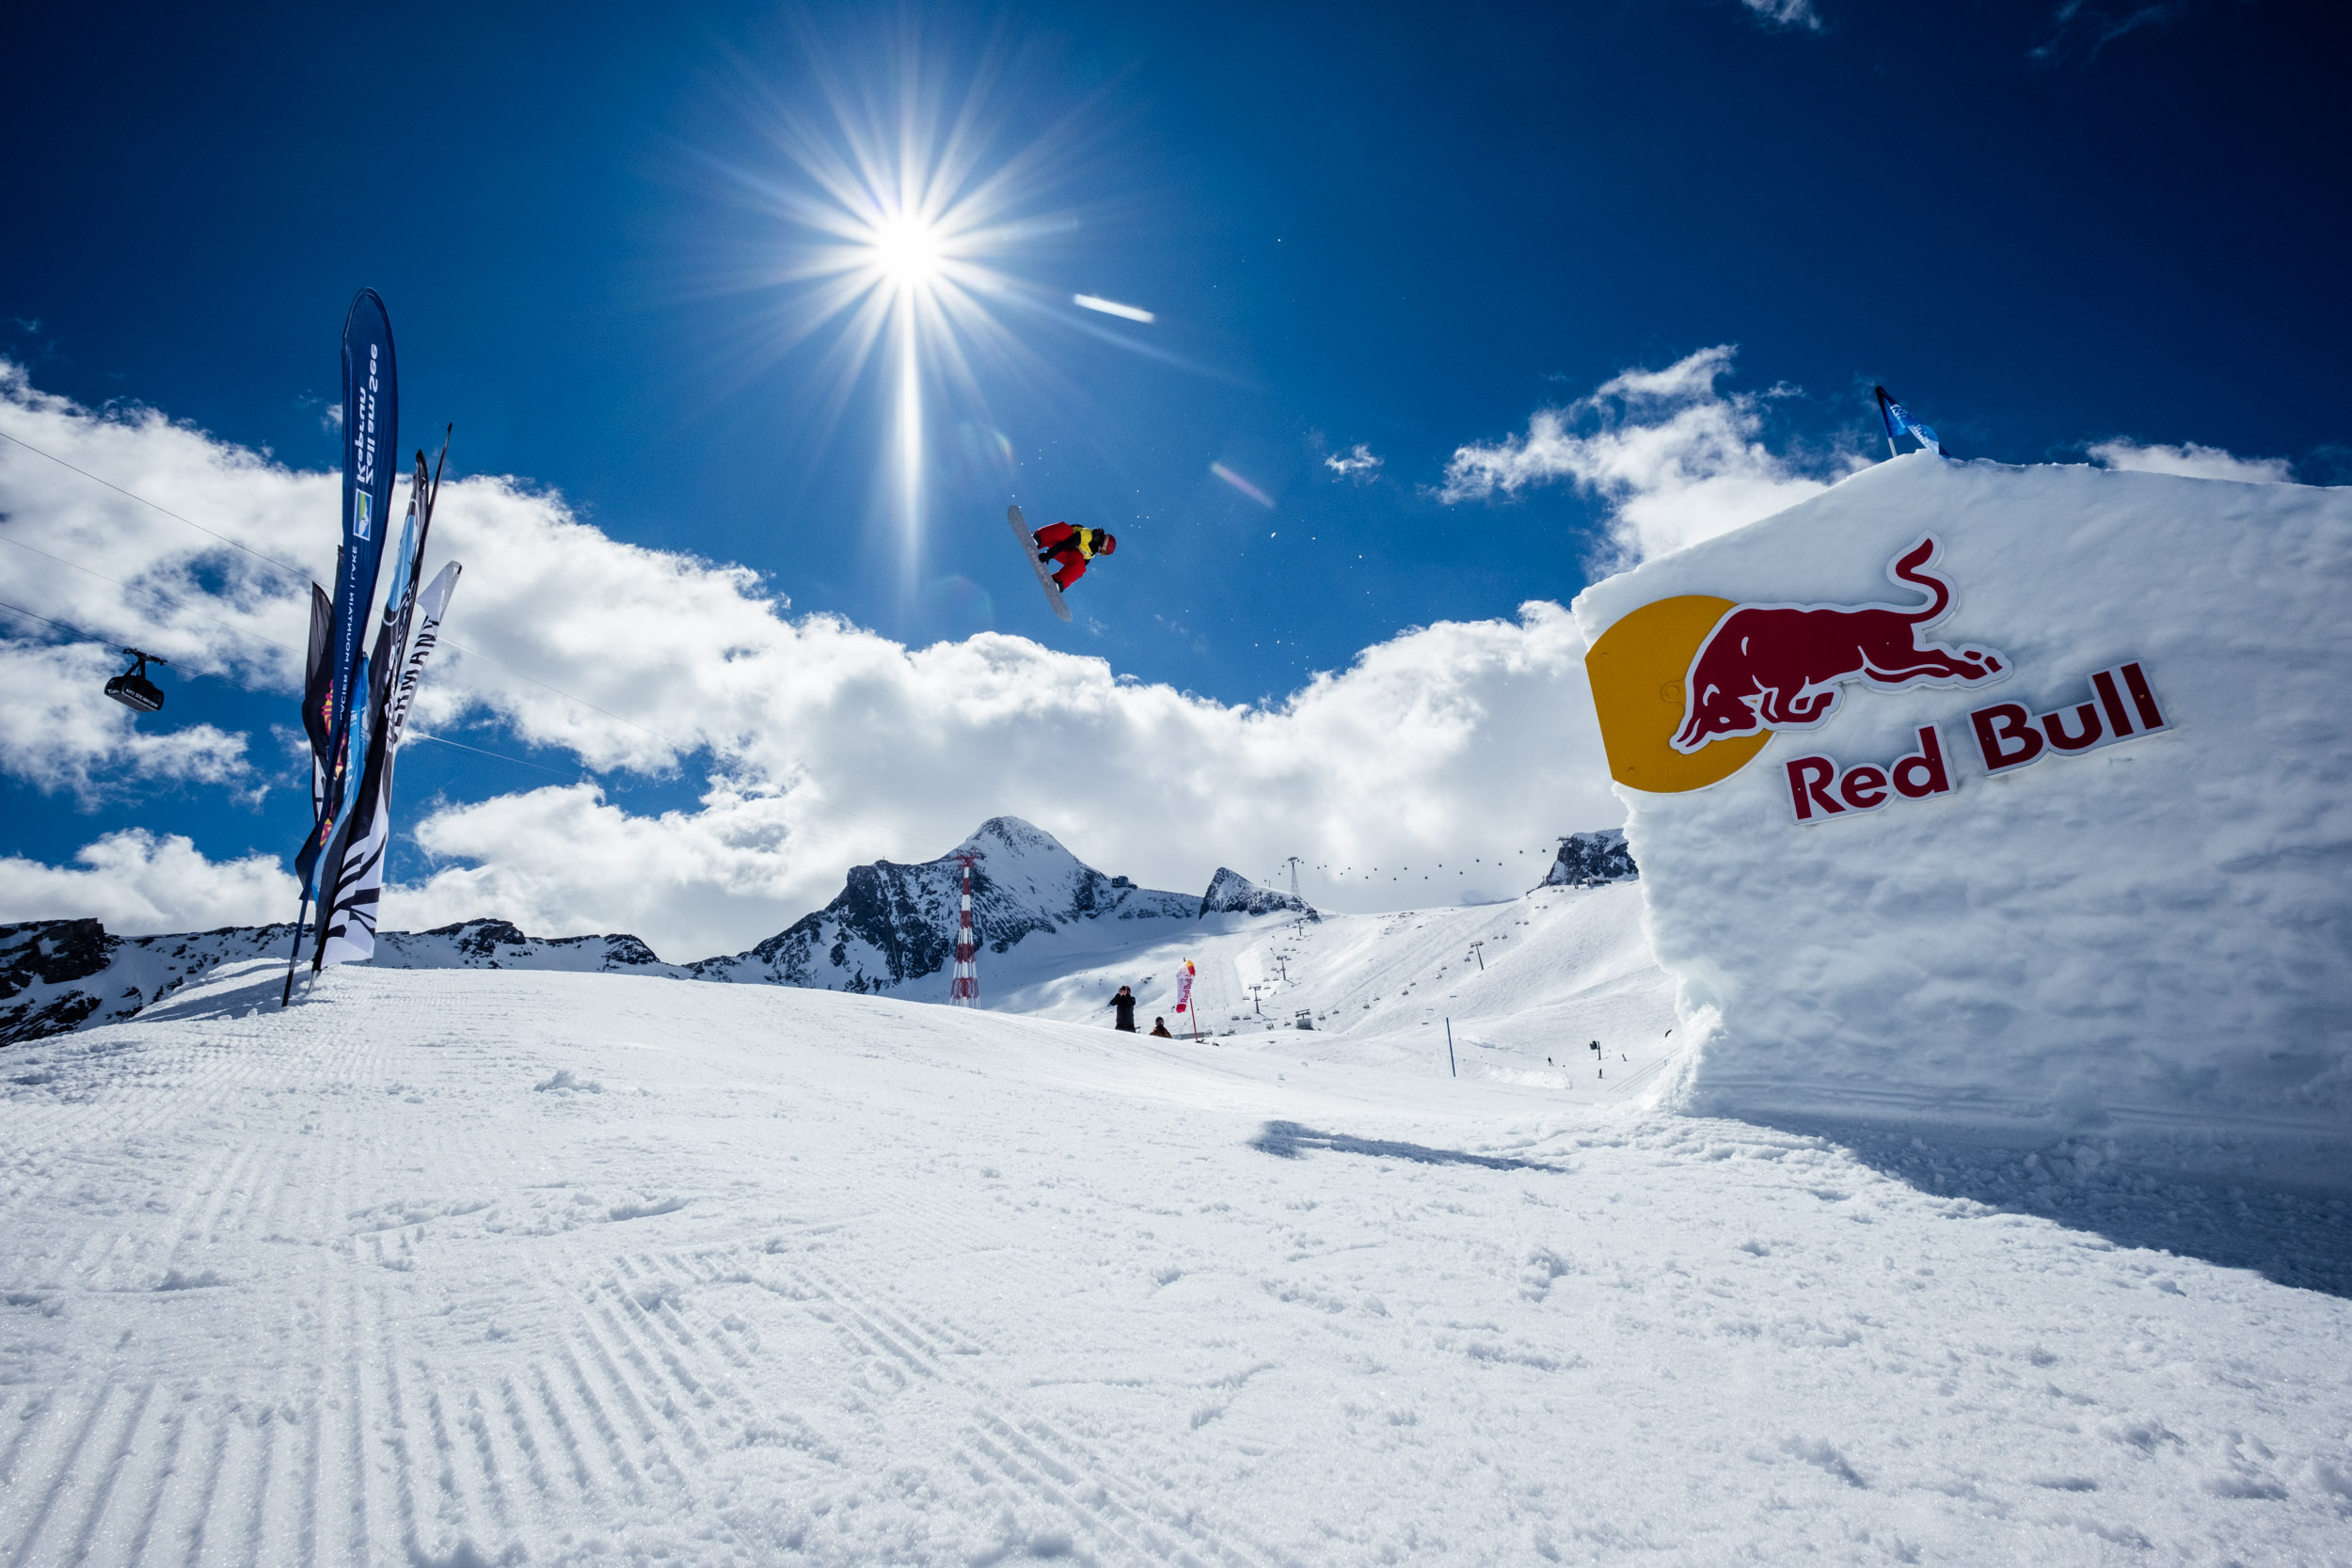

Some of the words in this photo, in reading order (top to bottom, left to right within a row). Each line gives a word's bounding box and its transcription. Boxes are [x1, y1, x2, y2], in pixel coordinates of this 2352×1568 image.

[1786, 725, 1950, 820] Red
[1970, 662, 2165, 771] Bull
[1184, 978, 1193, 990] Bull
[1180, 990, 1189, 1003] Red
